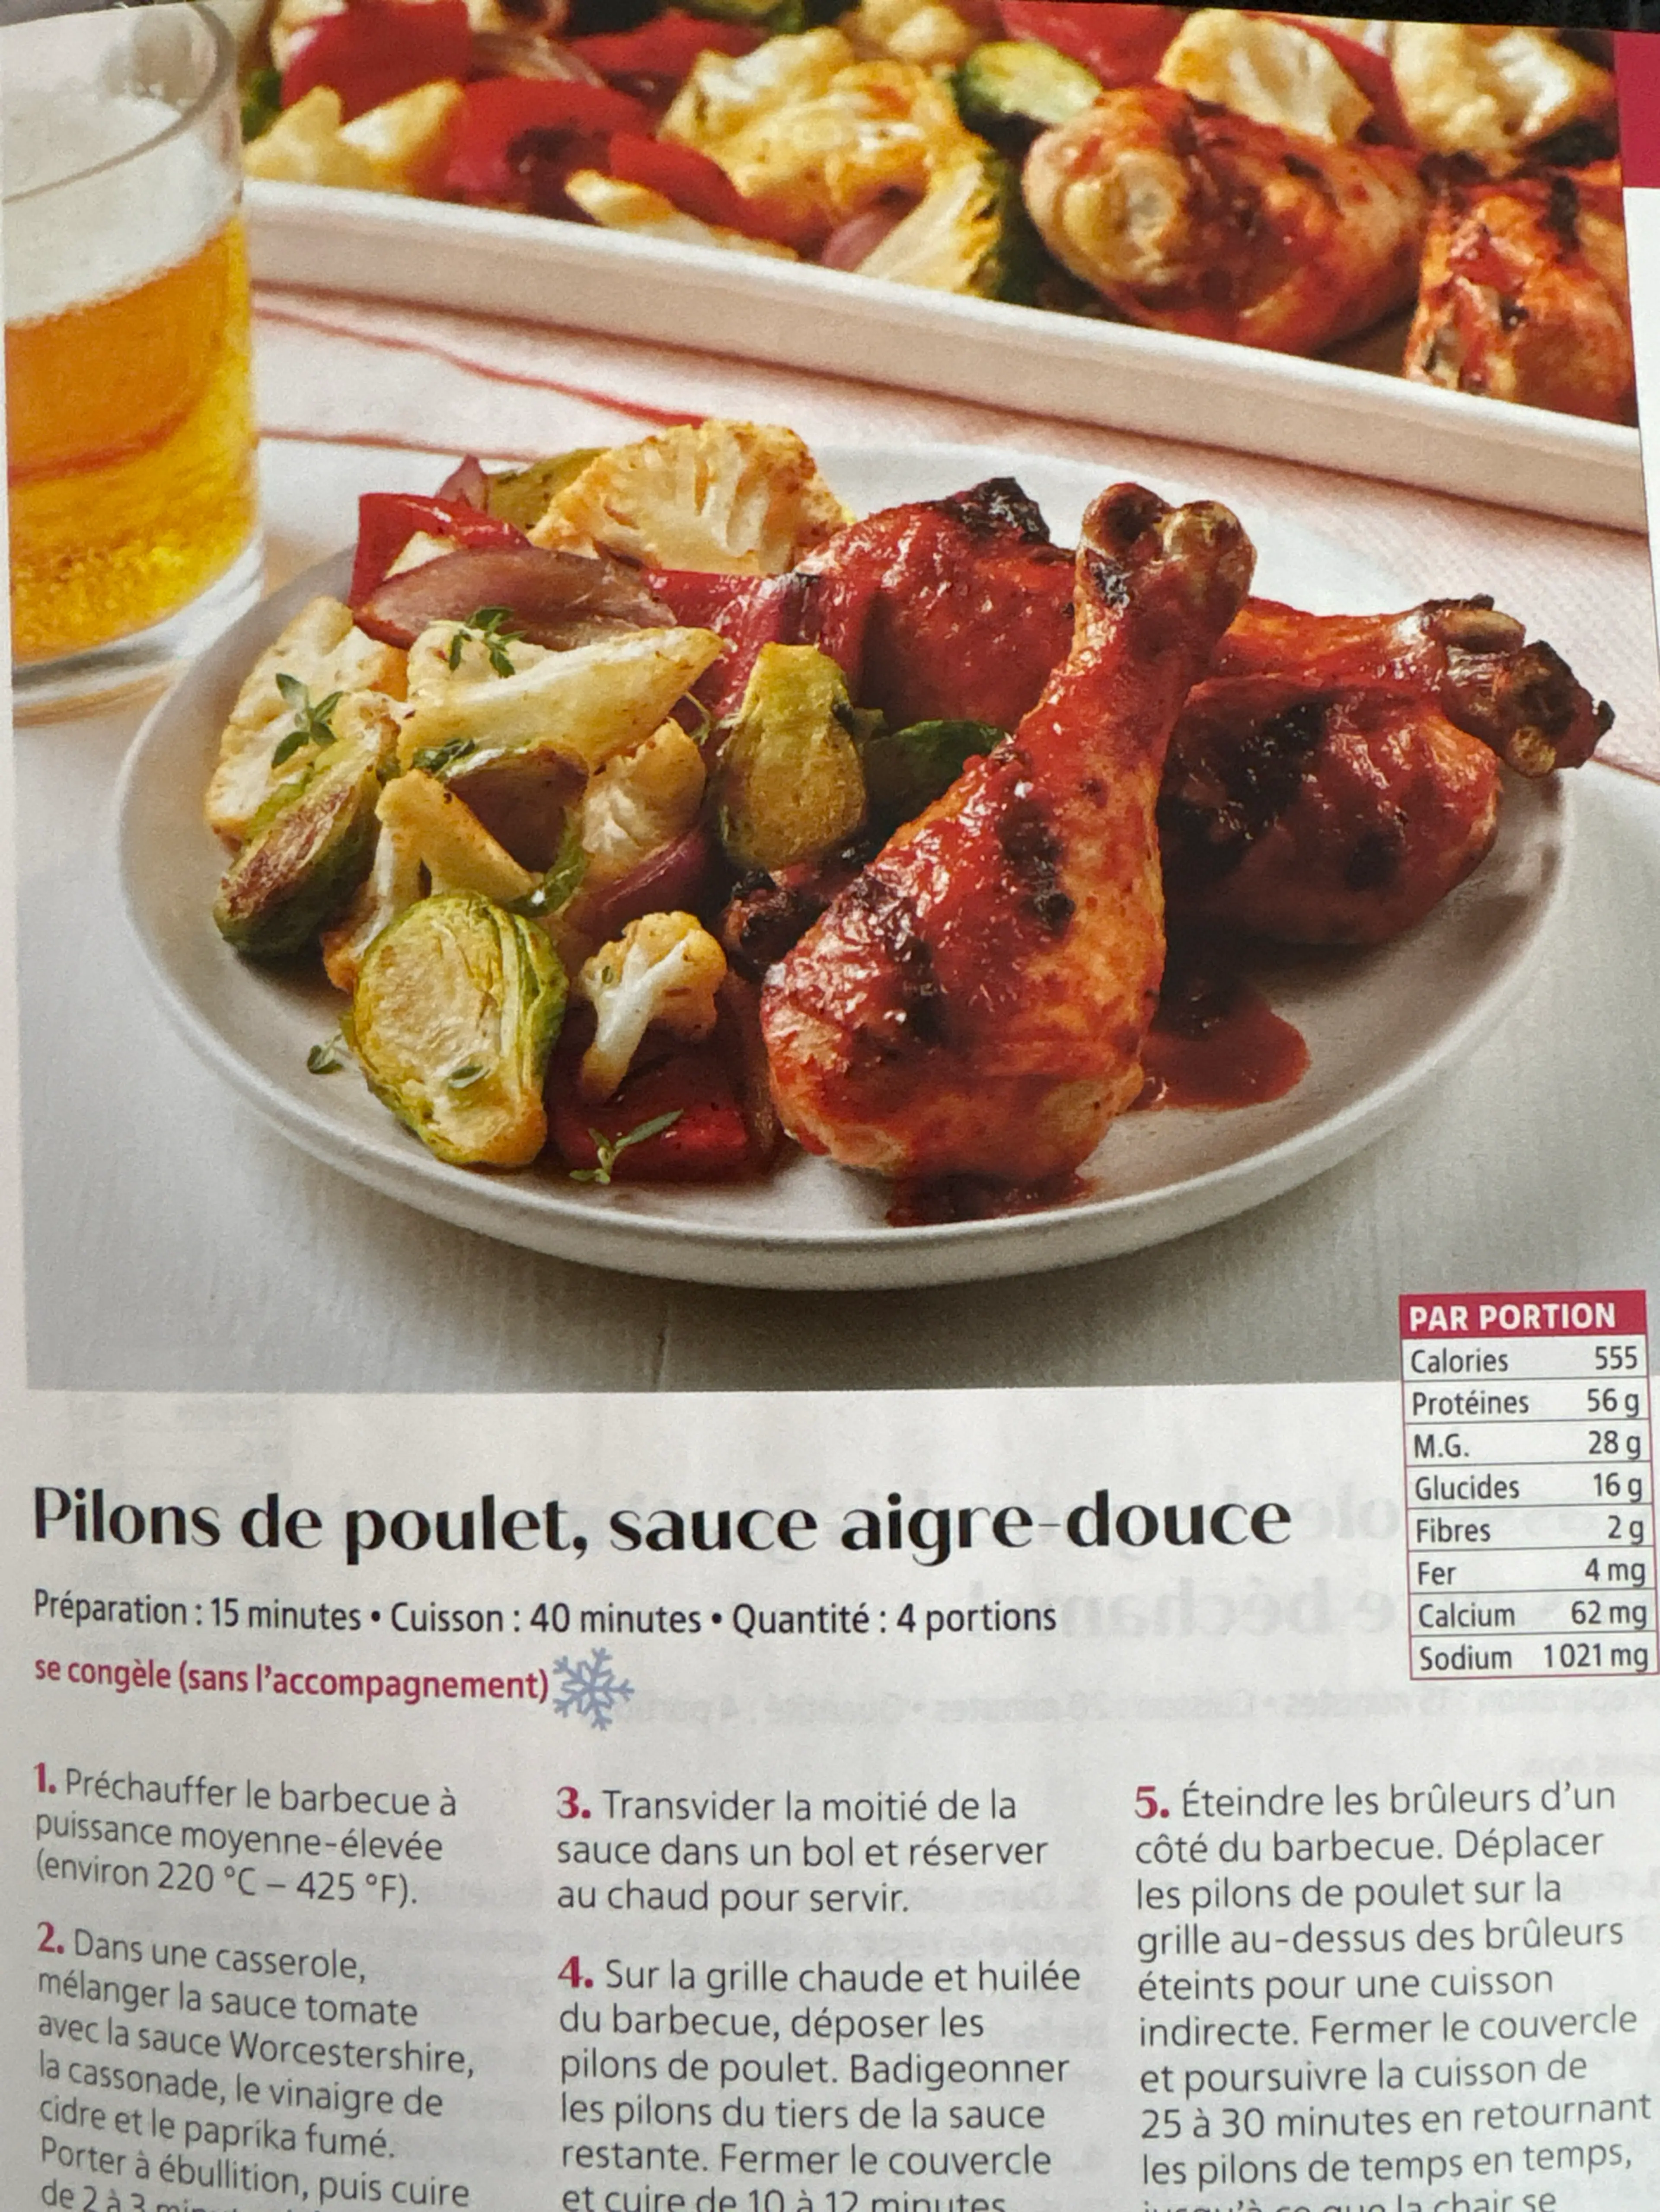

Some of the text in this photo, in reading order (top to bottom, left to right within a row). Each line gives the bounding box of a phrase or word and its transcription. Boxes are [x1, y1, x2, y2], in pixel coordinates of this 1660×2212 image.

[1410, 1302, 1616, 1332] PAR PORTION
[1411, 1345, 1638, 1374] Calories 555
[1413, 1388, 1640, 1417] Protéines 56 g
[1414, 1430, 1641, 1460] M.G. 28 g
[1415, 1472, 1642, 1502] Glucides 16 g
[34, 1486, 221, 1547] Pilons
[240, 1492, 322, 1549] de
[345, 1494, 588, 1566] poulet,
[609, 1509, 817, 1552] sauce
[840, 1488, 1292, 1567] aigre-douce
[1416, 1514, 1644, 1544] Fibres 2 g
[1417, 1557, 1645, 1586] Fer 4 mg
[211, 1597, 239, 1627] 15
[248, 1598, 361, 1631] minutes
[530, 1602, 570, 1633] 40
[580, 1602, 702, 1634] minutes
[896, 1603, 916, 1633] 4
[926, 1600, 1057, 1641] portions
[1418, 1600, 1647, 1629] Calcium 62 mg
[35, 1659, 61, 1681] se
[68, 1658, 171, 1694] congèle
[179, 1660, 248, 1694] (sans
[1420, 1644, 1512, 1671] Sodium
[1610, 1644, 1648, 1673] mg
[34, 1762, 456, 1816] 1. Préchauffer le barbecue à
[557, 1786, 1016, 1822] 3. Transvider la moitié de la
[1135, 1785, 1170, 1819] 5.
[1182, 1780, 1324, 1817] Éteindre
[1335, 1784, 1379, 1815] les
[1391, 1782, 1530, 1814] brûleurs
[37, 1814, 442, 1861] puissance moyenne-élevée
[557, 1835, 1048, 1867] sauce dans un bol et réserver
[1136, 1826, 1604, 1865] côté du barbecue. Déplacer
[37, 1848, 148, 1887] (environ
[158, 1861, 214, 1893] 220
[297, 1871, 354, 1901] 425
[1137, 1872, 1561, 1916] les pilons de poulet sur la
[558, 1879, 908, 1919] au chaud pour servir.
[38, 1922, 365, 1984] 2. Dans une casserole,
[1137, 1917, 1623, 1963] grille au-dessus des brûleurs
[558, 1955, 1080, 1998] 4. Sur la grille chaude et huilée
[1138, 1967, 1552, 2007] éteints pour une cuisson
[39, 1970, 418, 2026] mélanger la sauce tomate
[560, 2002, 984, 2046] du barbecue, déposer les
[1140, 2004, 1637, 2047] indirecte. Fermer le couvercle
[39, 2015, 473, 2078] avec la sauce Worcestershire,
[41, 2049, 443, 2120] la cassonade, le vinaigre de
[562, 2047, 1069, 2091] pilons de poulet. Badigeonner
[1140, 2050, 1587, 2100] et poursuivre la cuisson de
[562, 2091, 1045, 2131] les pilons du tiers de la sauce
[1141, 2094, 1651, 2139] 25 à 30 minutes en retournant
